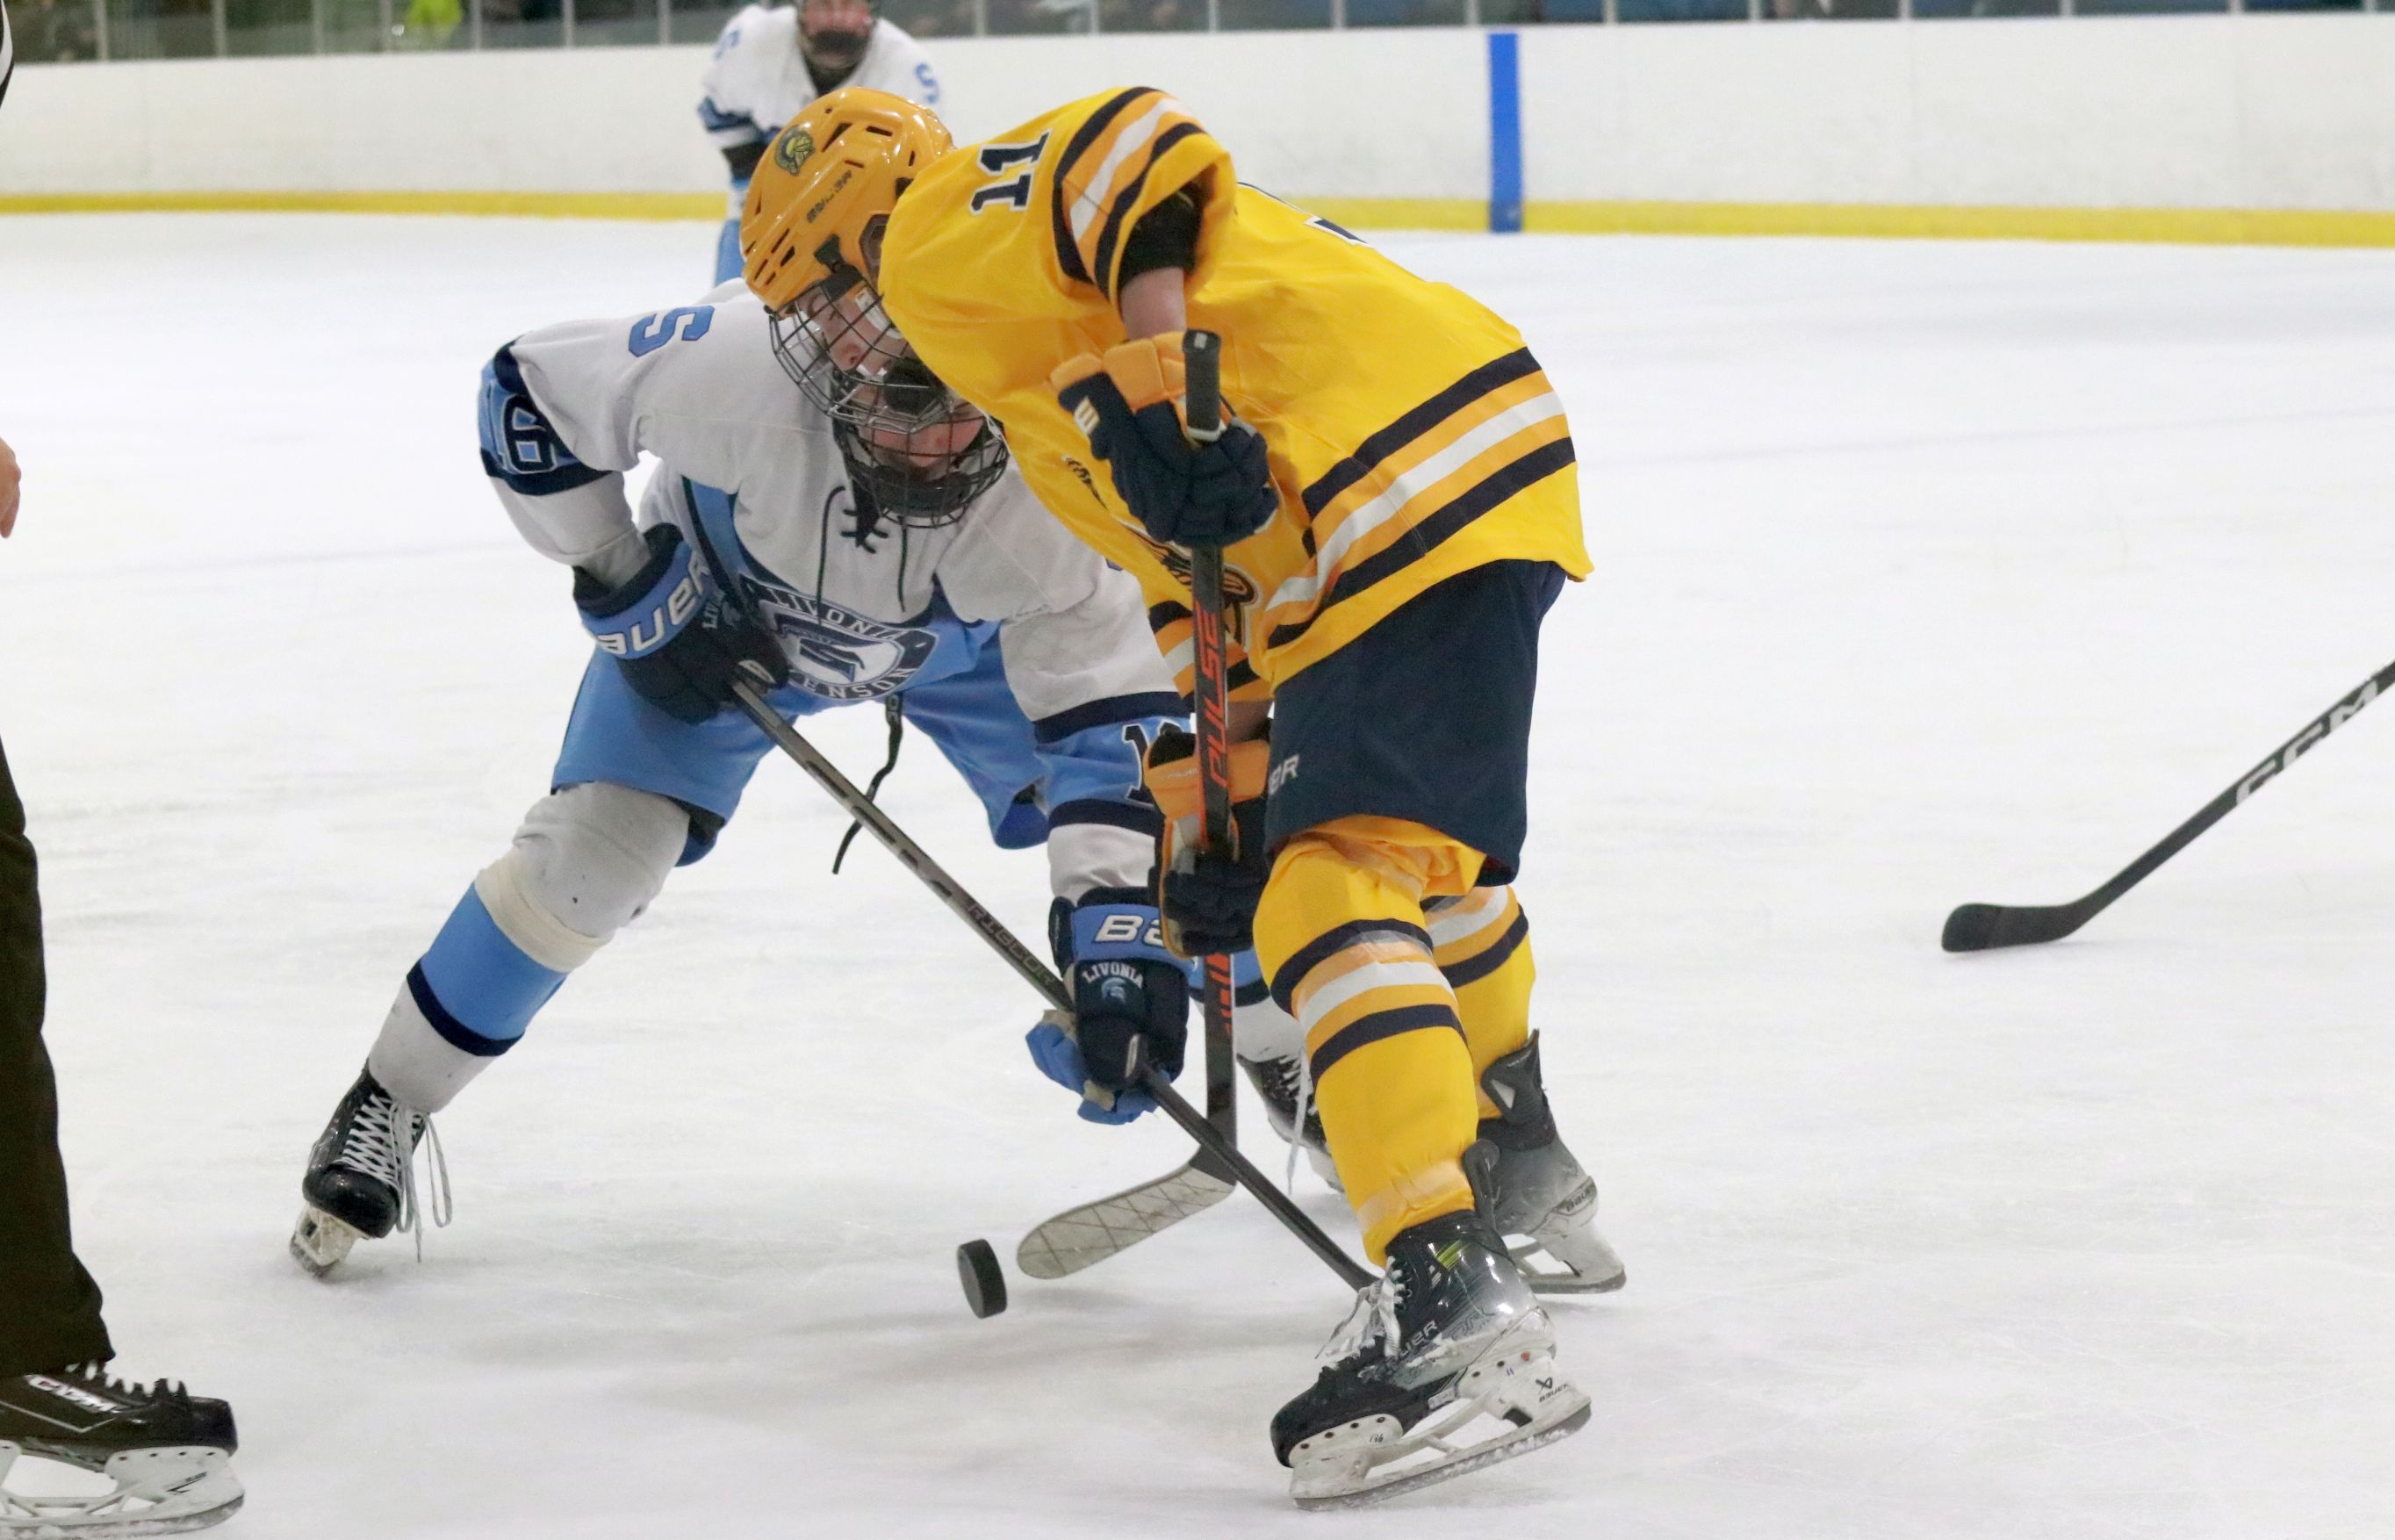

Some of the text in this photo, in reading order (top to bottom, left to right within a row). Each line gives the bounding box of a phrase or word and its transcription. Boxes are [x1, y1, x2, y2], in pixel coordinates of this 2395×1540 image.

[970, 129, 1052, 214] 11
[597, 551, 709, 655] AUER
[1195, 599, 1228, 788] PULSE
[1082, 961, 1145, 989] LIVONIA
